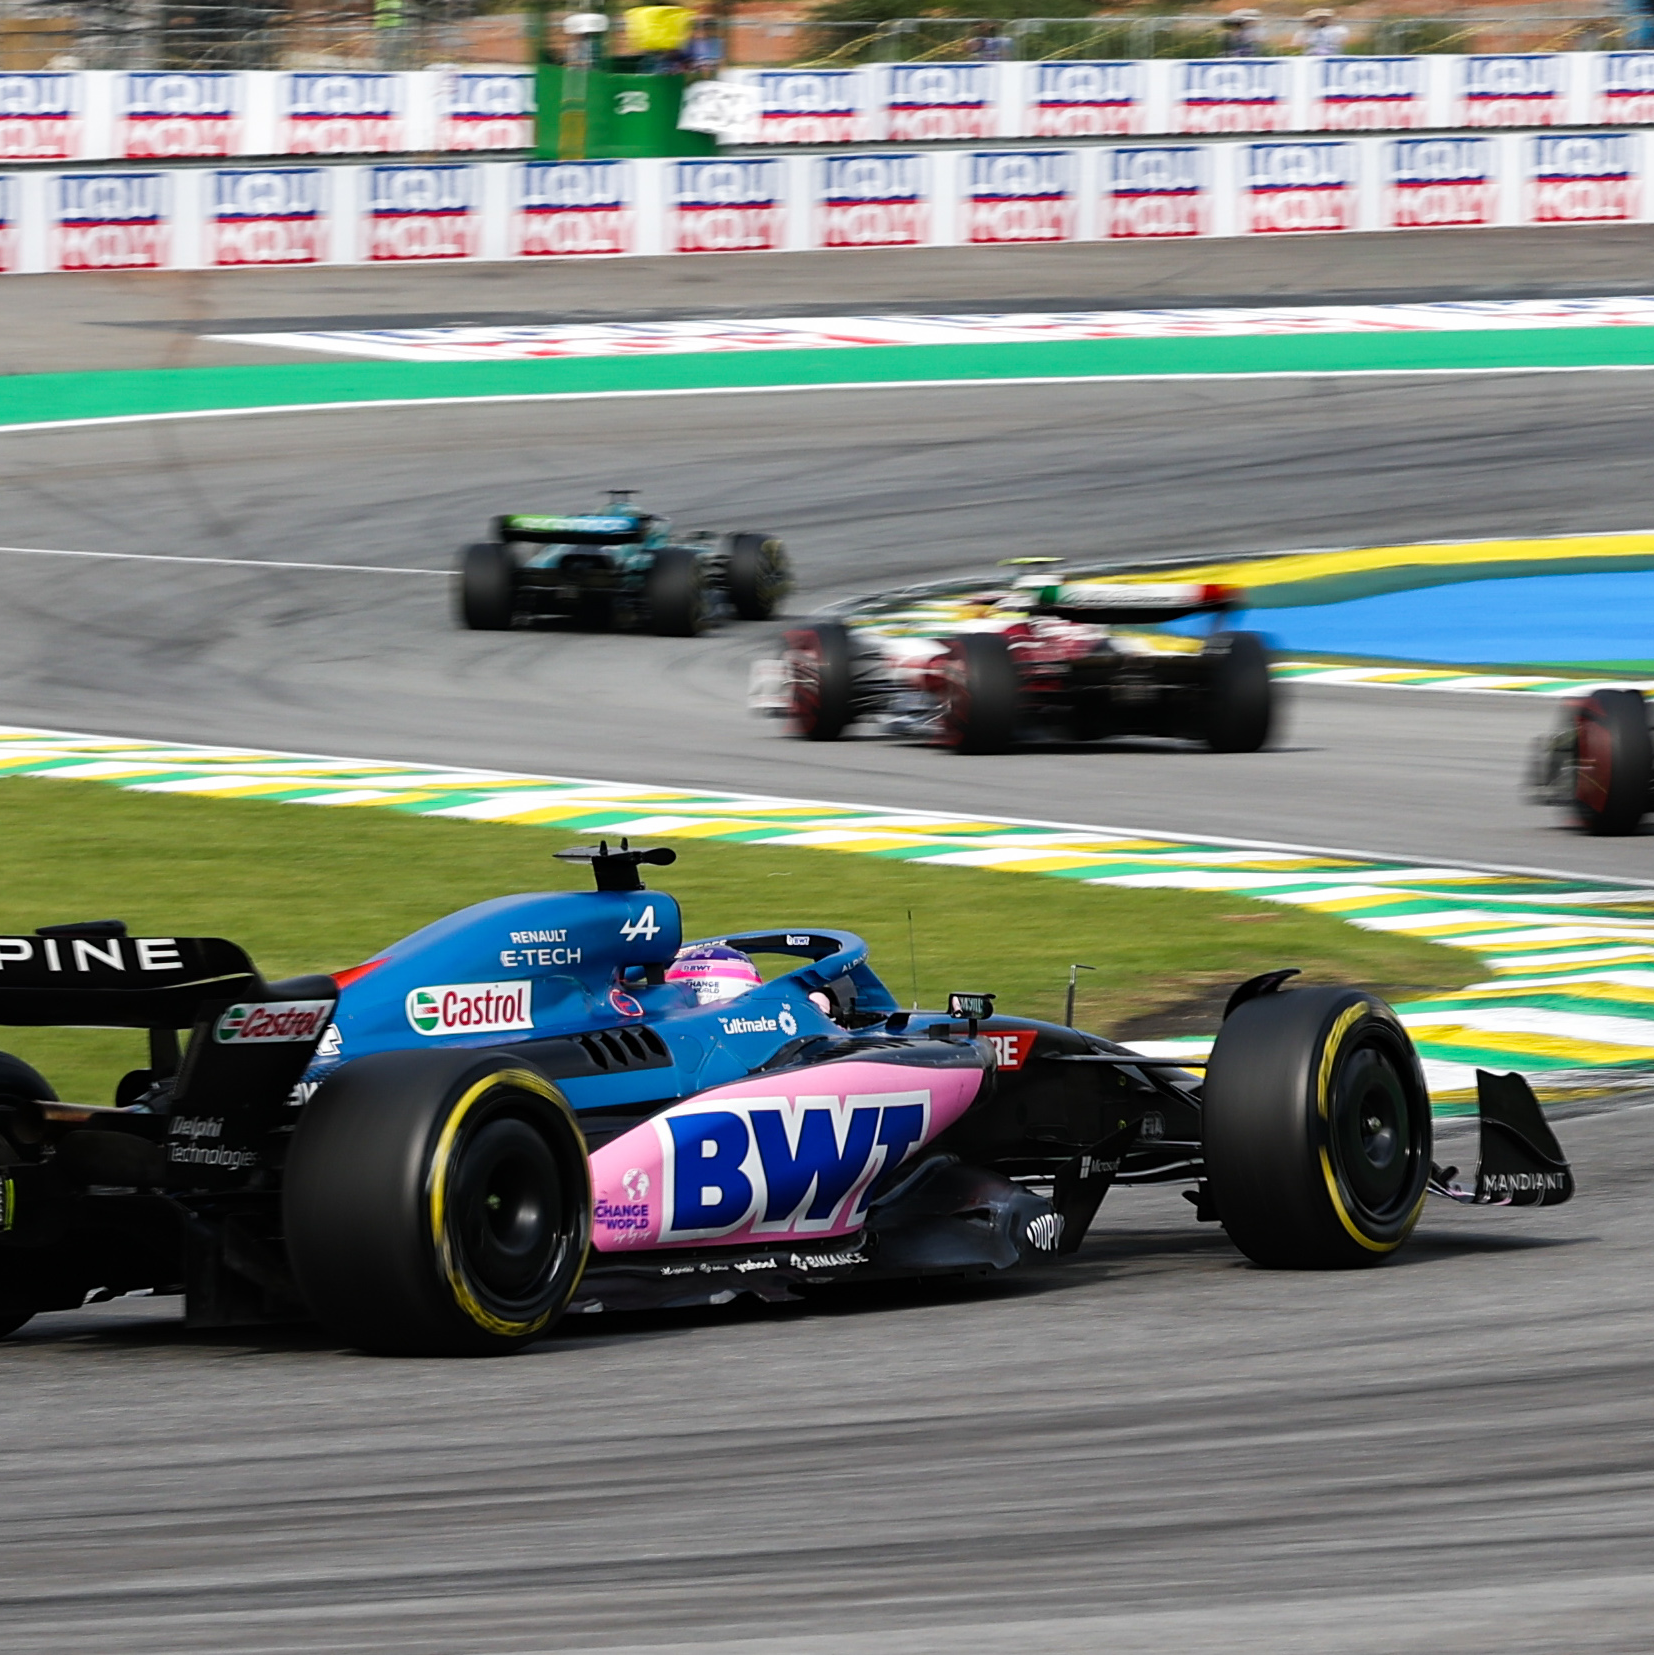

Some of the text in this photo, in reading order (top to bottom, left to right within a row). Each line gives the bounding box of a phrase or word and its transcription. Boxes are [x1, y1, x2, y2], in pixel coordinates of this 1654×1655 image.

[510, 929, 567, 944] RENAULT
[500, 948, 582, 967] E-TECH
[443, 988, 525, 1027] Castrol
[239, 1006, 327, 1039] Castrol
[723, 1016, 777, 1034] ultimate
[168, 1116, 224, 1140] Delphi
[663, 1100, 926, 1234] BWT
[1483, 1173, 1565, 1191] MANDIANT
[594, 1205, 649, 1218] CHANGE
[607, 1218, 649, 1230] WORLD
[806, 1252, 869, 1268] BINANCE
